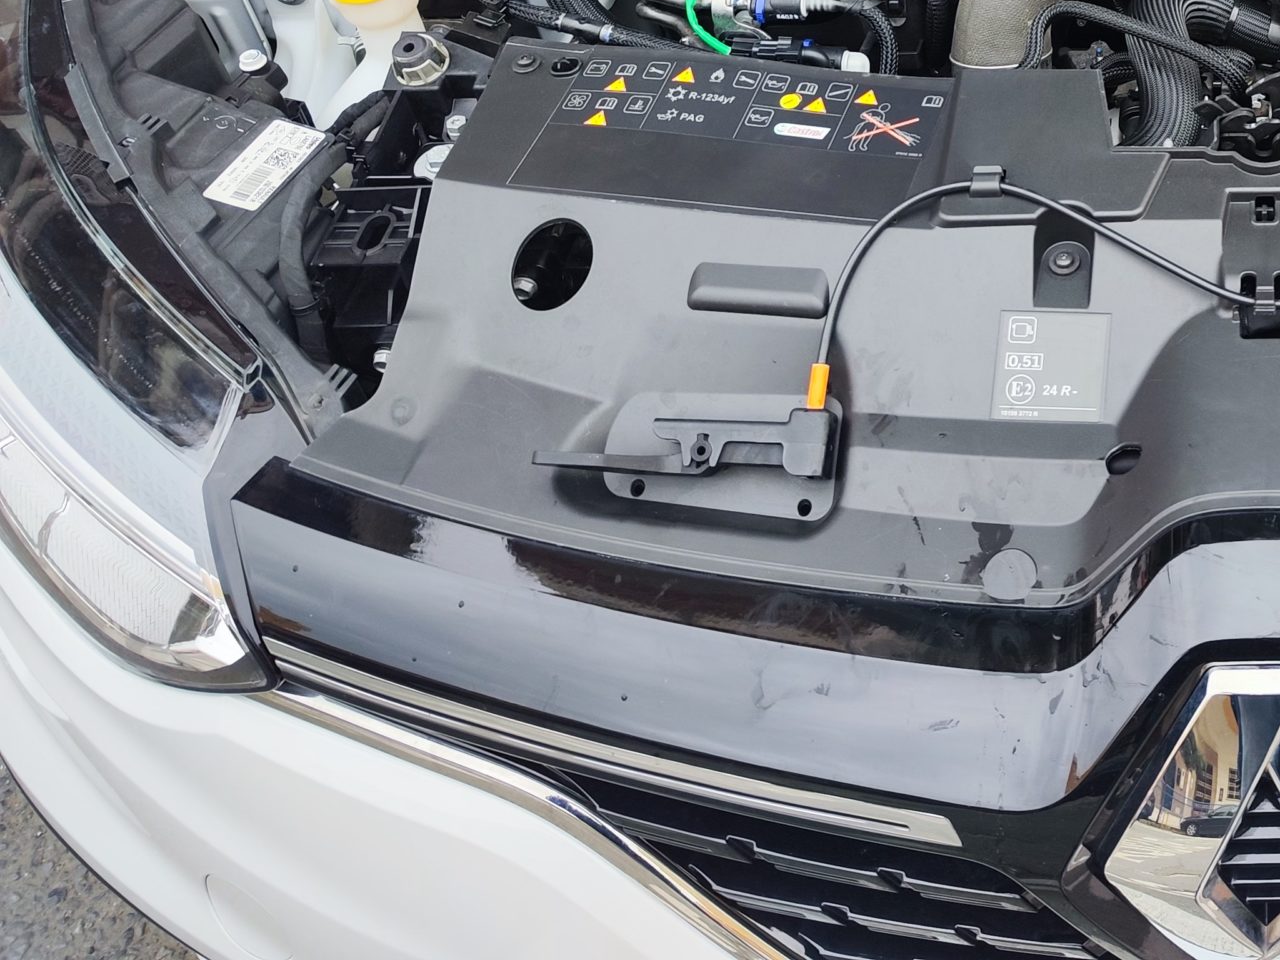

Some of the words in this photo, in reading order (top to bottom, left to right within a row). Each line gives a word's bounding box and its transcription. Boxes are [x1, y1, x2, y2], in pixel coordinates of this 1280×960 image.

[688, 91, 736, 105] R-1234yf
[680, 112, 705, 123] PAG
[1008, 355, 1040, 369] 0,51
[1042, 384, 1058, 396] 24
